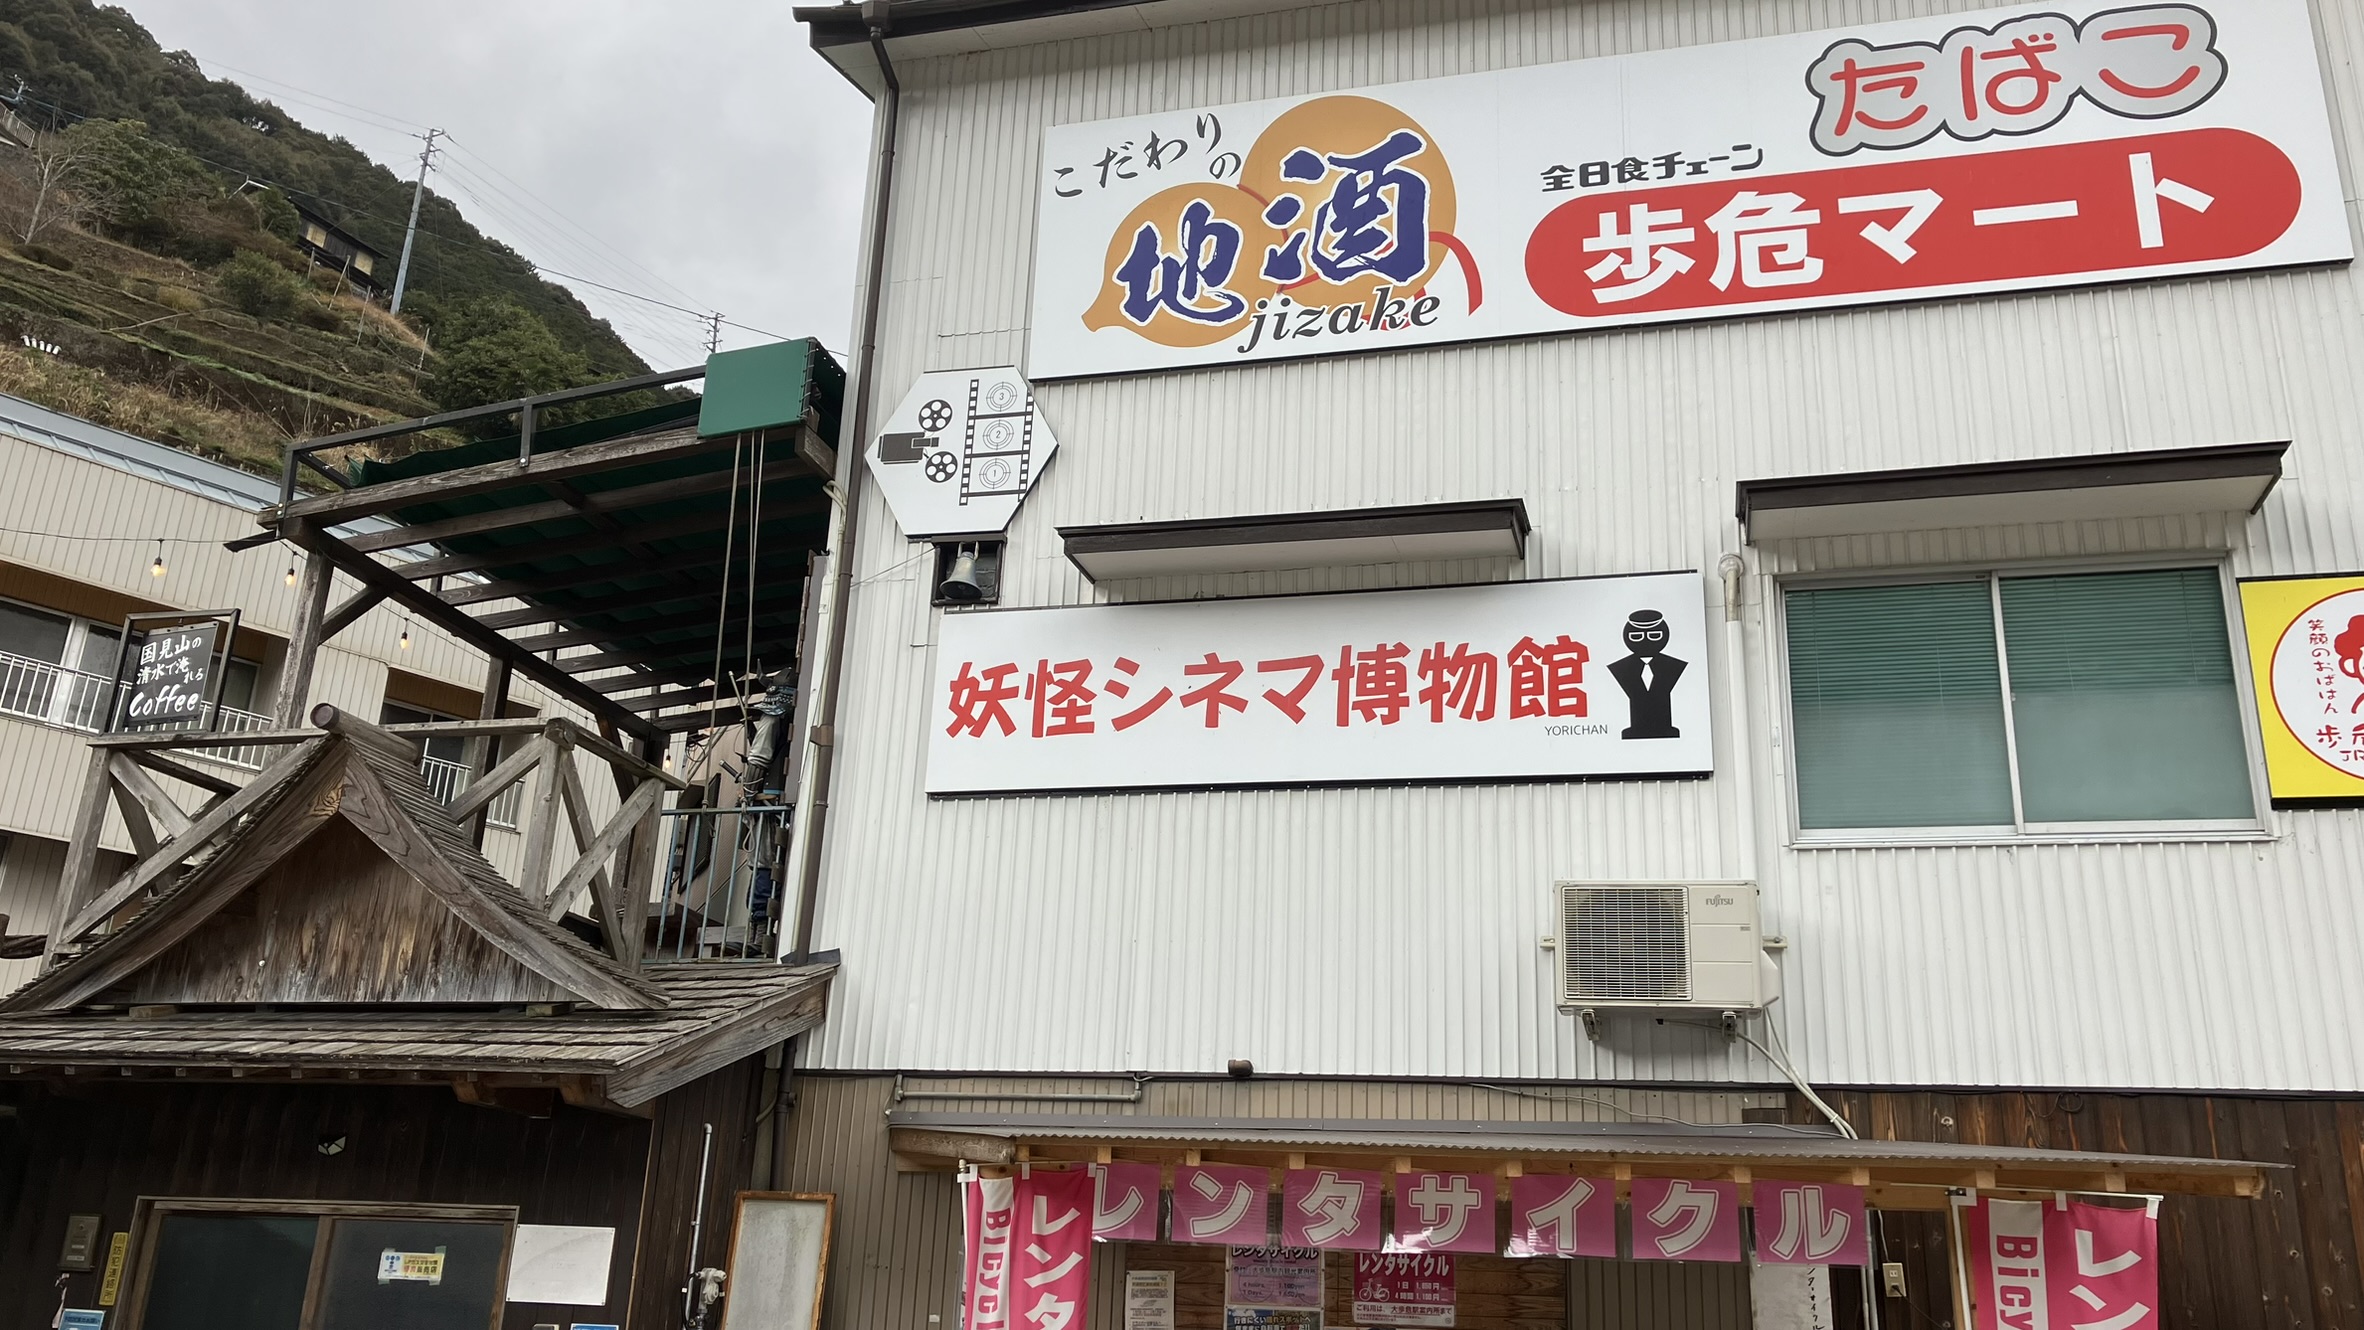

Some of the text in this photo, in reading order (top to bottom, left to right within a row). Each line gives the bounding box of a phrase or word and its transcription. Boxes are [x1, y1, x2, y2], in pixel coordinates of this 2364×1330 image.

[1831, 23, 2201, 136] たばこ
[1053, 113, 1242, 198] こだわりの
[1540, 144, 1763, 192] 全日食チェーン
[1113, 129, 1428, 326] 地酒
[1581, 151, 2215, 305] 歩危マート
[1237, 286, 1442, 355] jizake
[995, 430, 1003, 439] 2
[999, 392, 1006, 401] 3
[140, 634, 202, 665] 国見山の
[946, 634, 1590, 739] 妖怪シネマ博物館
[2308, 619, 2338, 715] 笑顔のおばはん
[129, 684, 199, 717] Coffee
[1544, 724, 1608, 736] YORICHAN
[1024, 1195, 1083, 1330] レンタ
[1231, 1244, 1319, 1259] レンタサイクル
[1359, 1252, 1450, 1277] レンタサイクル
[1996, 1234, 2040, 1330] Bicy
[2067, 1228, 2151, 1330] レン
